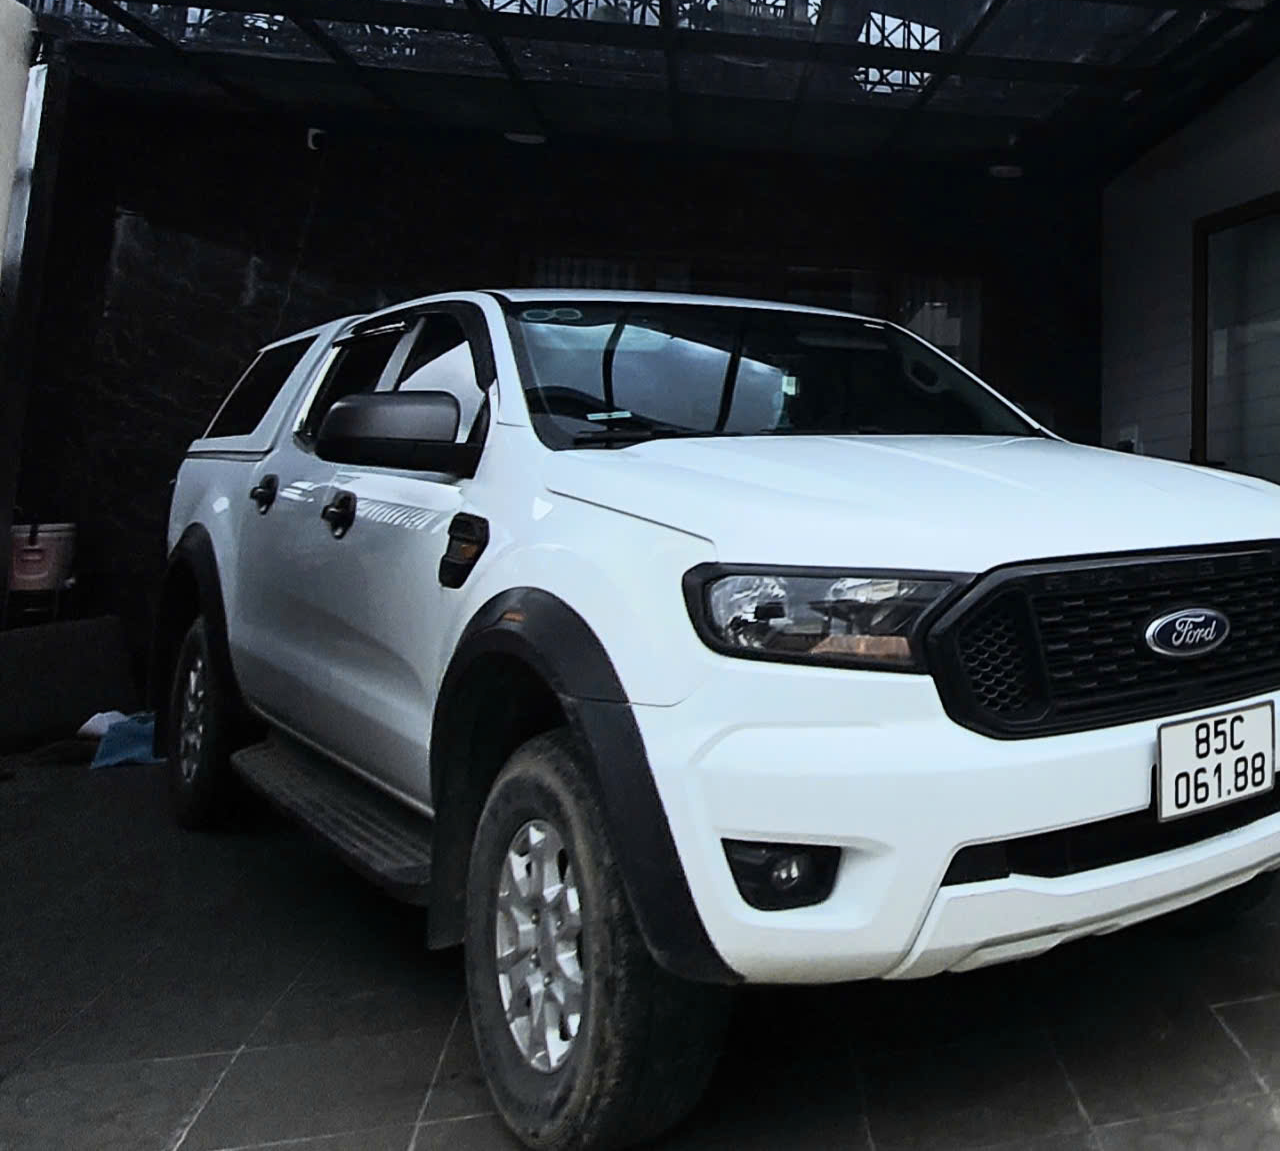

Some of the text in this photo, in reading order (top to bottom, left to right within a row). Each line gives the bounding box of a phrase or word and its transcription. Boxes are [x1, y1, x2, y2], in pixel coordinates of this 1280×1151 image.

[1172, 616, 1216, 646] Ford
[1195, 715, 1245, 759] 85C
[1174, 752, 1265, 809] 061.88
